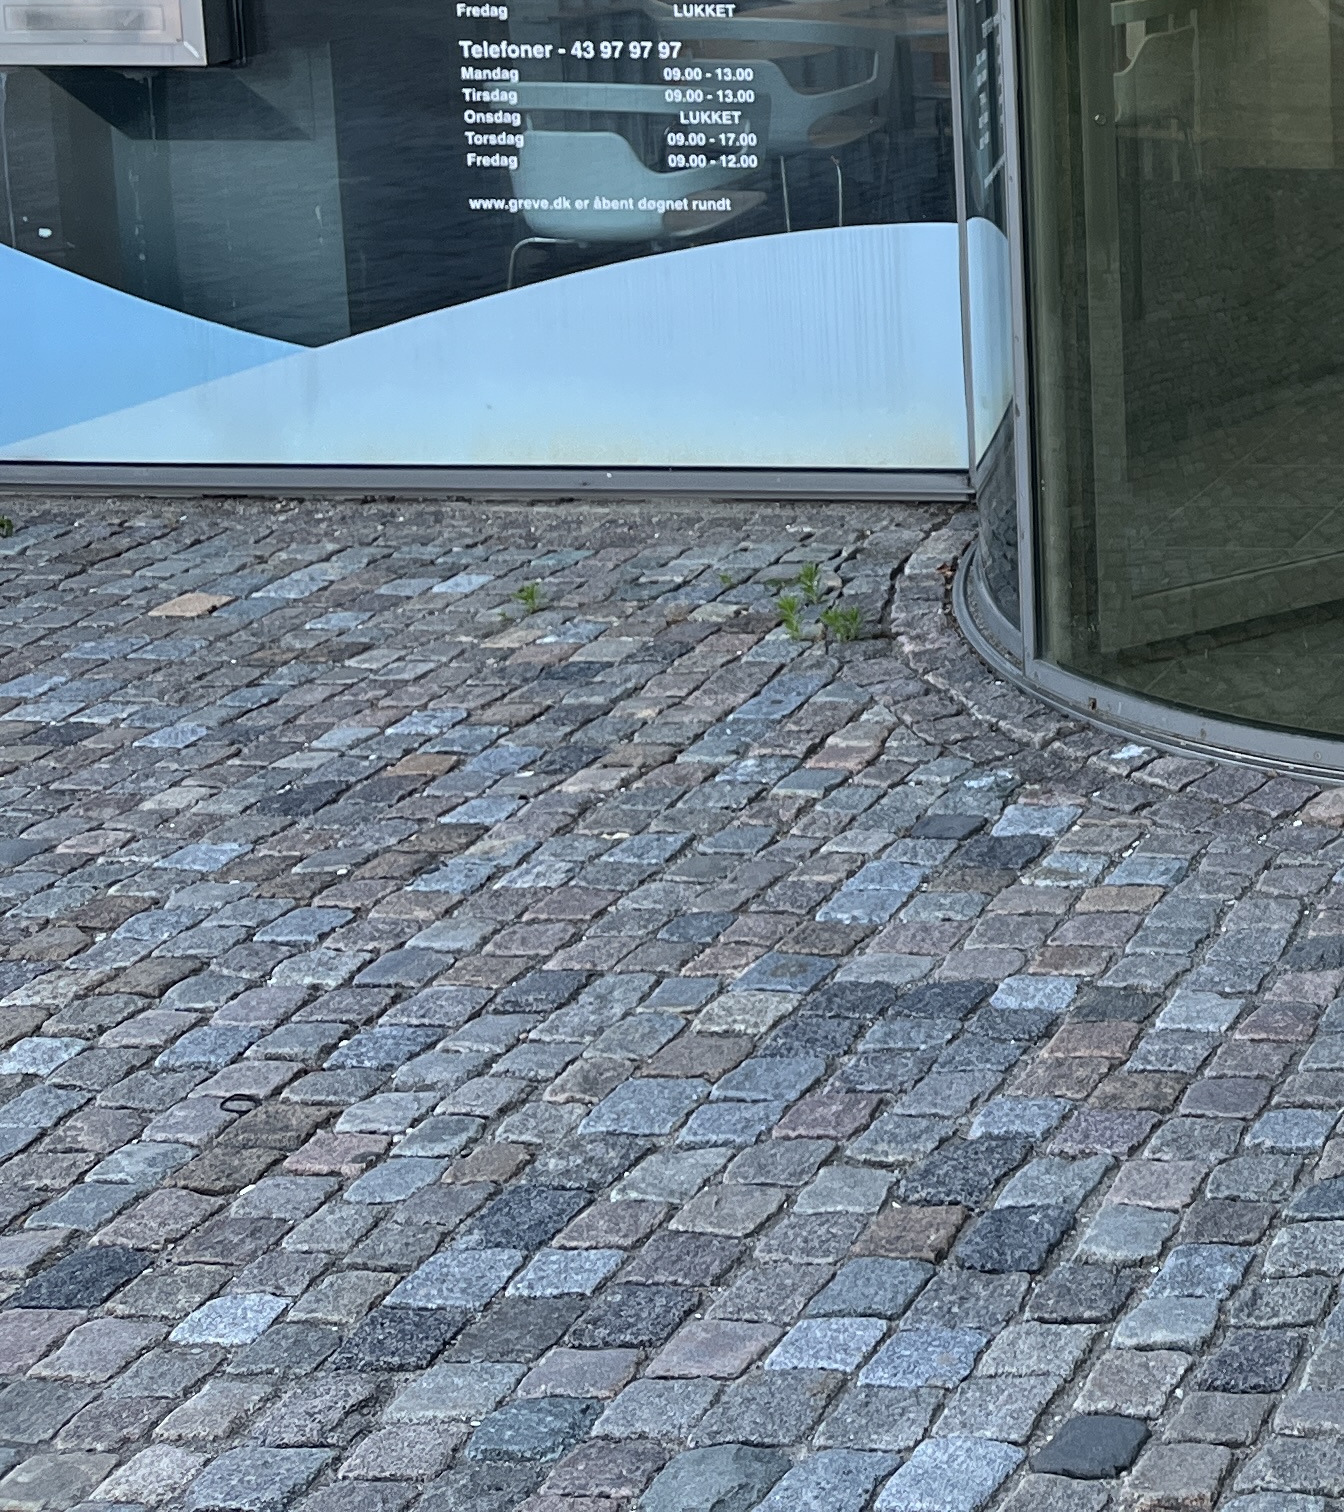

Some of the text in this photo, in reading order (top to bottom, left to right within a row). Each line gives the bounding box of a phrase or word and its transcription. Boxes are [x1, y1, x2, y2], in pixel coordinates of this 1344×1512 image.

[456, 3, 735, 20] Fredag LUKKET
[459, 40, 553, 59] Telefoner
[571, 41, 594, 59] 43
[600, 41, 623, 59] 97
[629, 41, 652, 59] 97
[659, 41, 682, 59] 97
[461, 67, 519, 83] Mandag
[663, 68, 702, 81] 09.00
[715, 68, 753, 81] 13.00
[462, 88, 517, 104] Tirsdag
[665, 90, 703, 103] 09.00
[716, 90, 755, 103] 13.00
[464, 110, 741, 126] Onsdag LUKKET
[465, 132, 524, 148] Torsdag
[667, 133, 706, 146] 09.00
[718, 133, 757, 146] 17.00
[467, 153, 518, 169] Fredag
[668, 155, 707, 168] 09.00
[719, 155, 758, 168] 12.00
[469, 198, 571, 212] www.greve.dk
[575, 200, 589, 211] er
[594, 197, 634, 211] åbent
[692, 198, 731, 211] rundt
